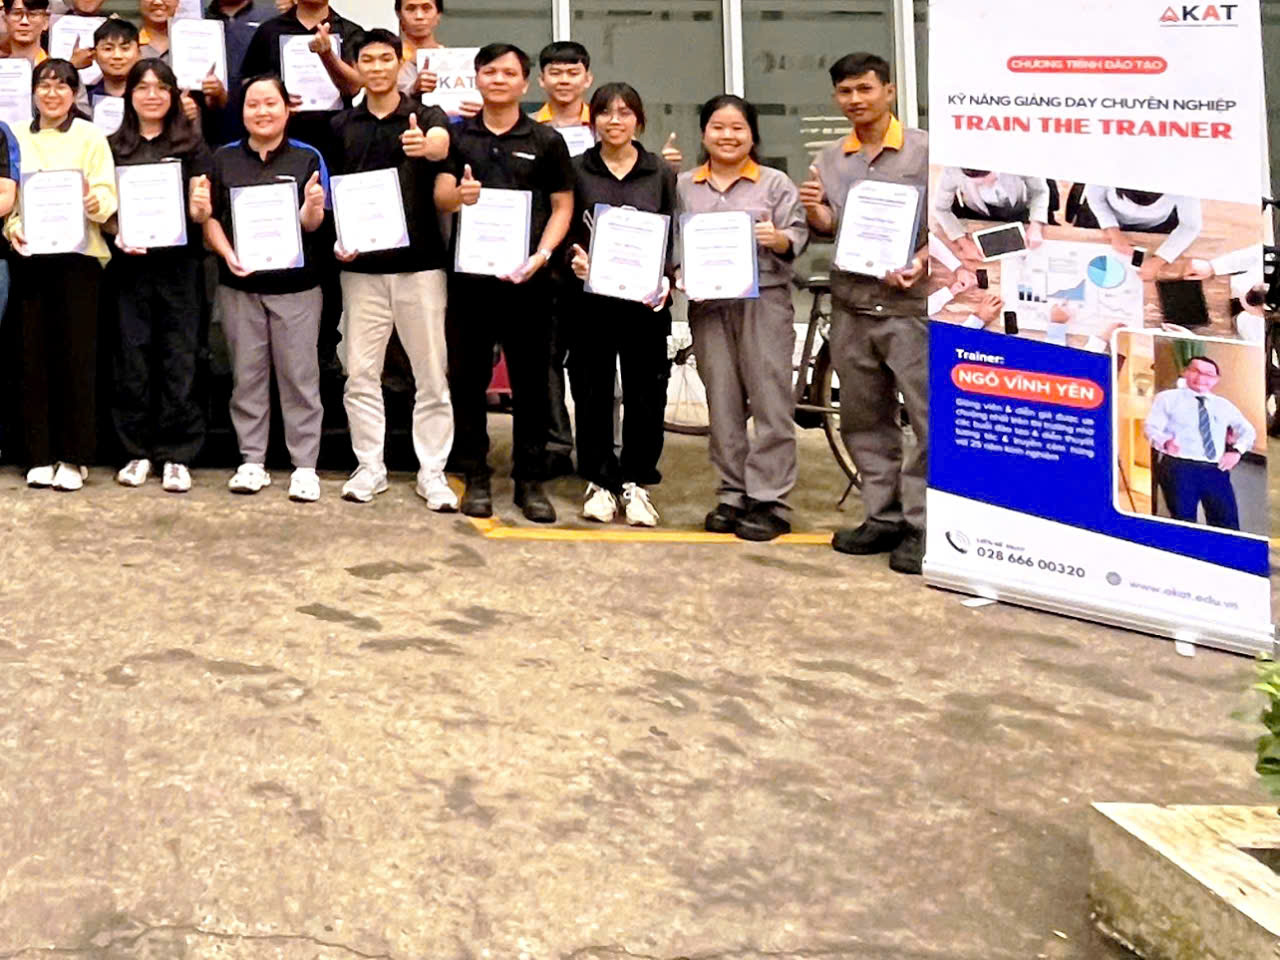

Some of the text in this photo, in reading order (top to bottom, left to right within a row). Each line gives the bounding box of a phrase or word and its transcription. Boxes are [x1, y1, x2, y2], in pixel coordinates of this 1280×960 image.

[440, 76, 477, 89] KAT
[952, 115, 1232, 140] TRAIN THE TRAINER
[955, 348, 1005, 364] Trainer:
[958, 370, 999, 387] NGÔ
[1056, 381, 1094, 401] YÊN
[977, 546, 1085, 578] 028 666 00320
